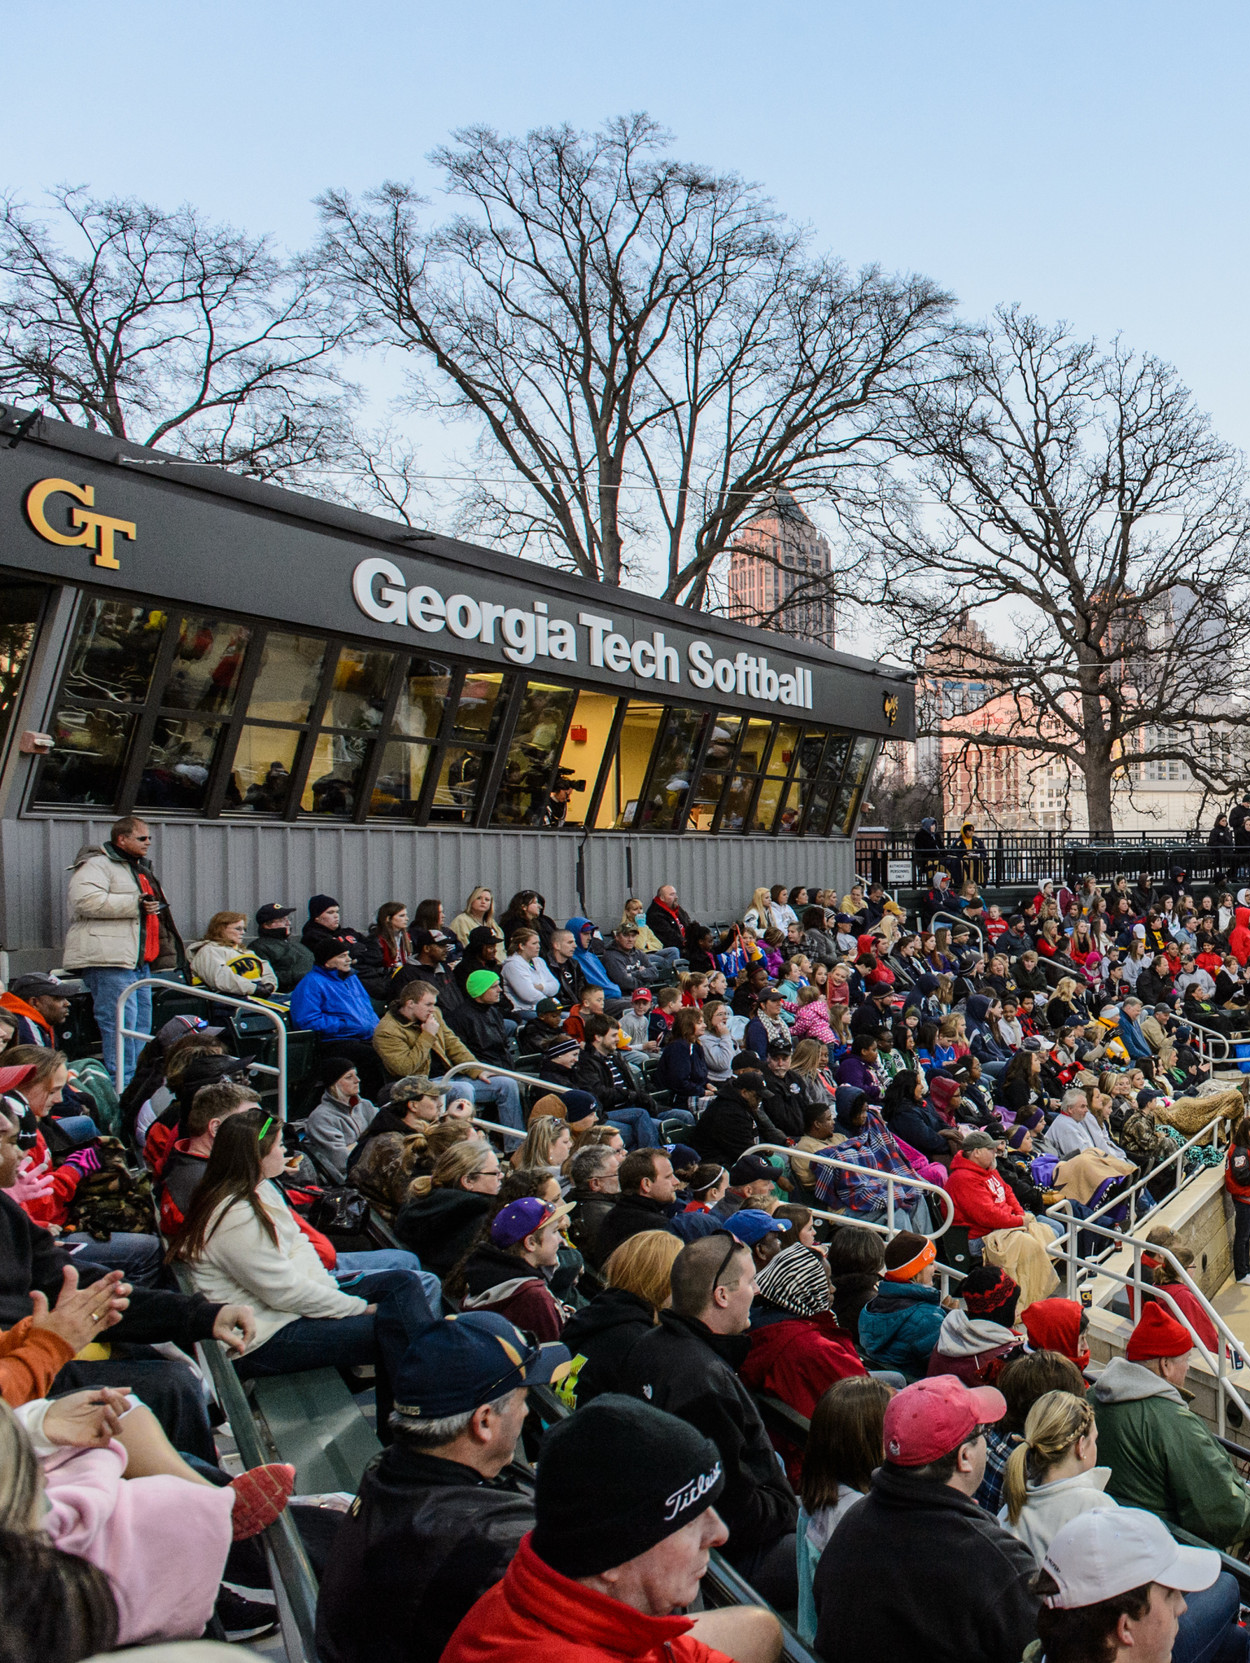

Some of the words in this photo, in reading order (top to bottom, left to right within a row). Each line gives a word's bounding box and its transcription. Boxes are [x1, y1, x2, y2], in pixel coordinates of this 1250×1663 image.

[27, 478, 136, 570] GT
[352, 557, 577, 664] Georgia
[579, 612, 680, 683] Tech
[688, 641, 813, 709] Softball
